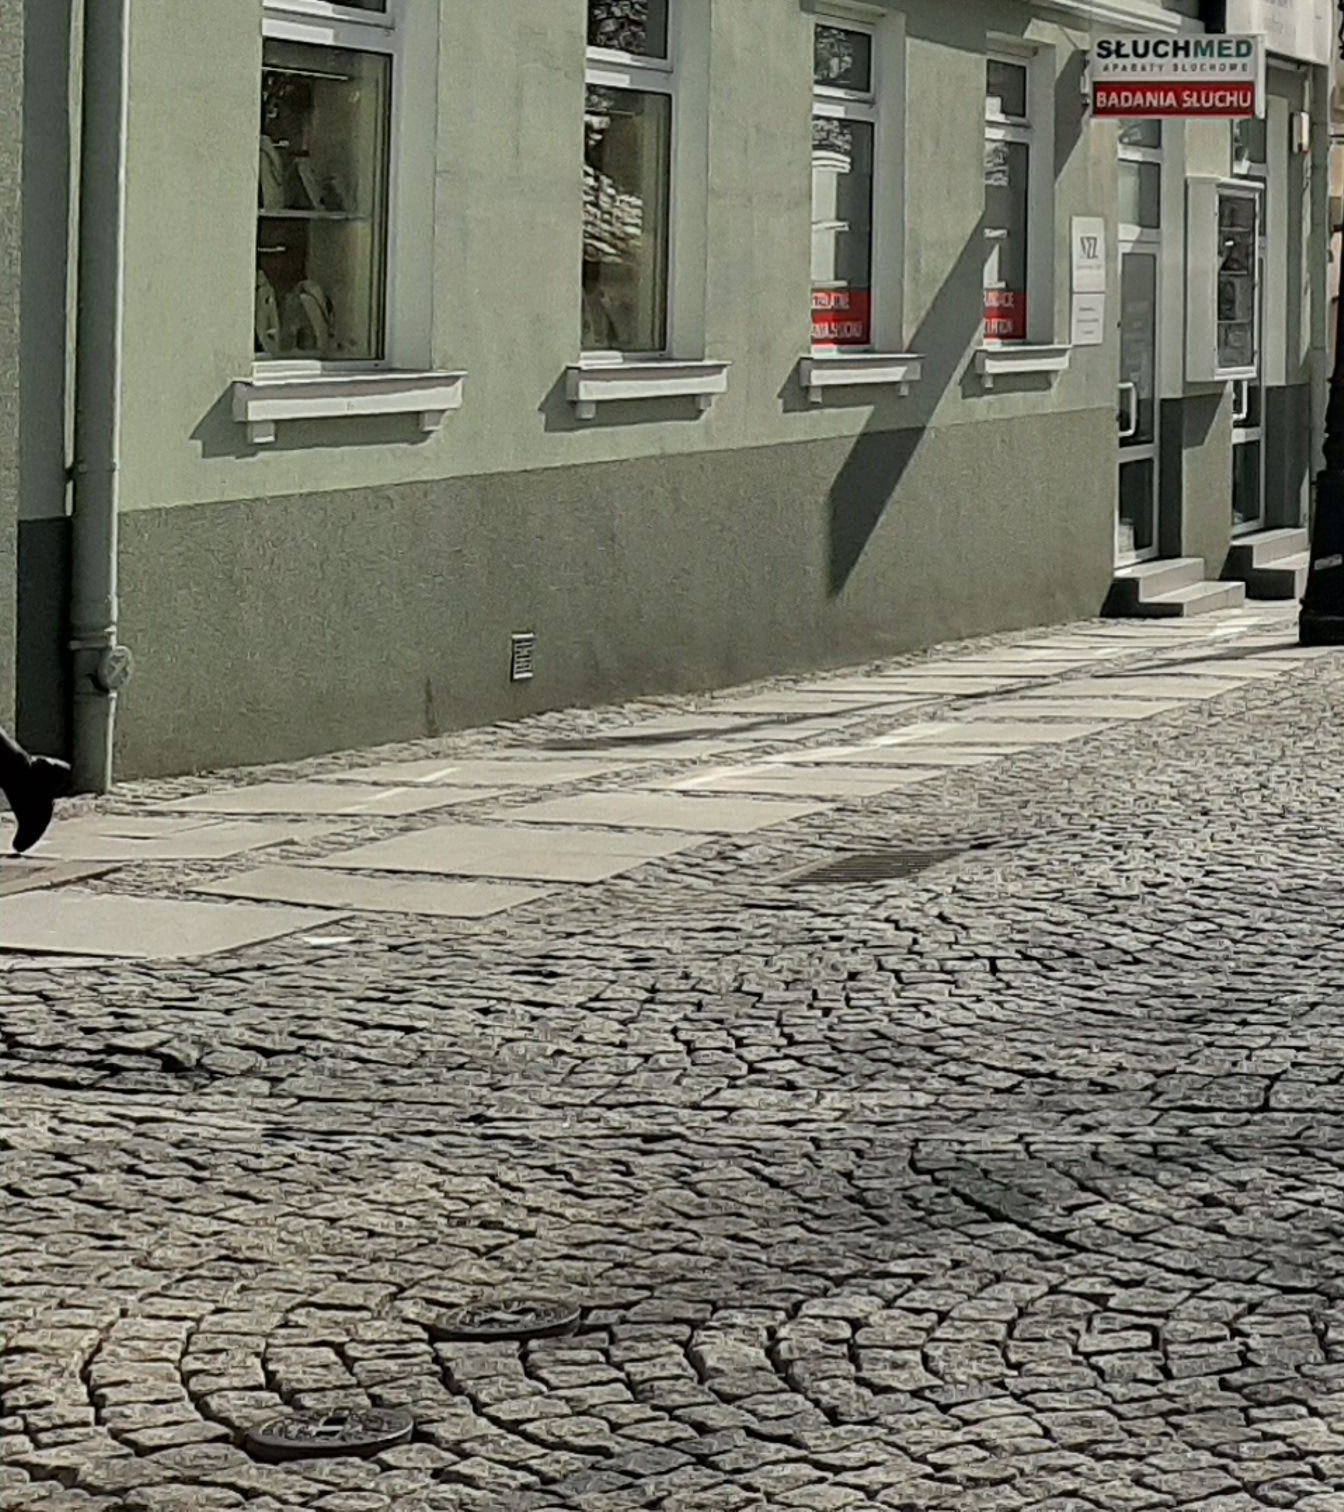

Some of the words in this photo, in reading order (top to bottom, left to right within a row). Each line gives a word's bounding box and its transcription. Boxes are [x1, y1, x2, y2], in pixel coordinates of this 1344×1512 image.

[1096, 39, 1253, 59] SŁUCHMED
[1102, 62, 1164, 73] APARATY
[1096, 91, 1177, 109] BADANIA
[1181, 89, 1252, 109] SŁUCHU
